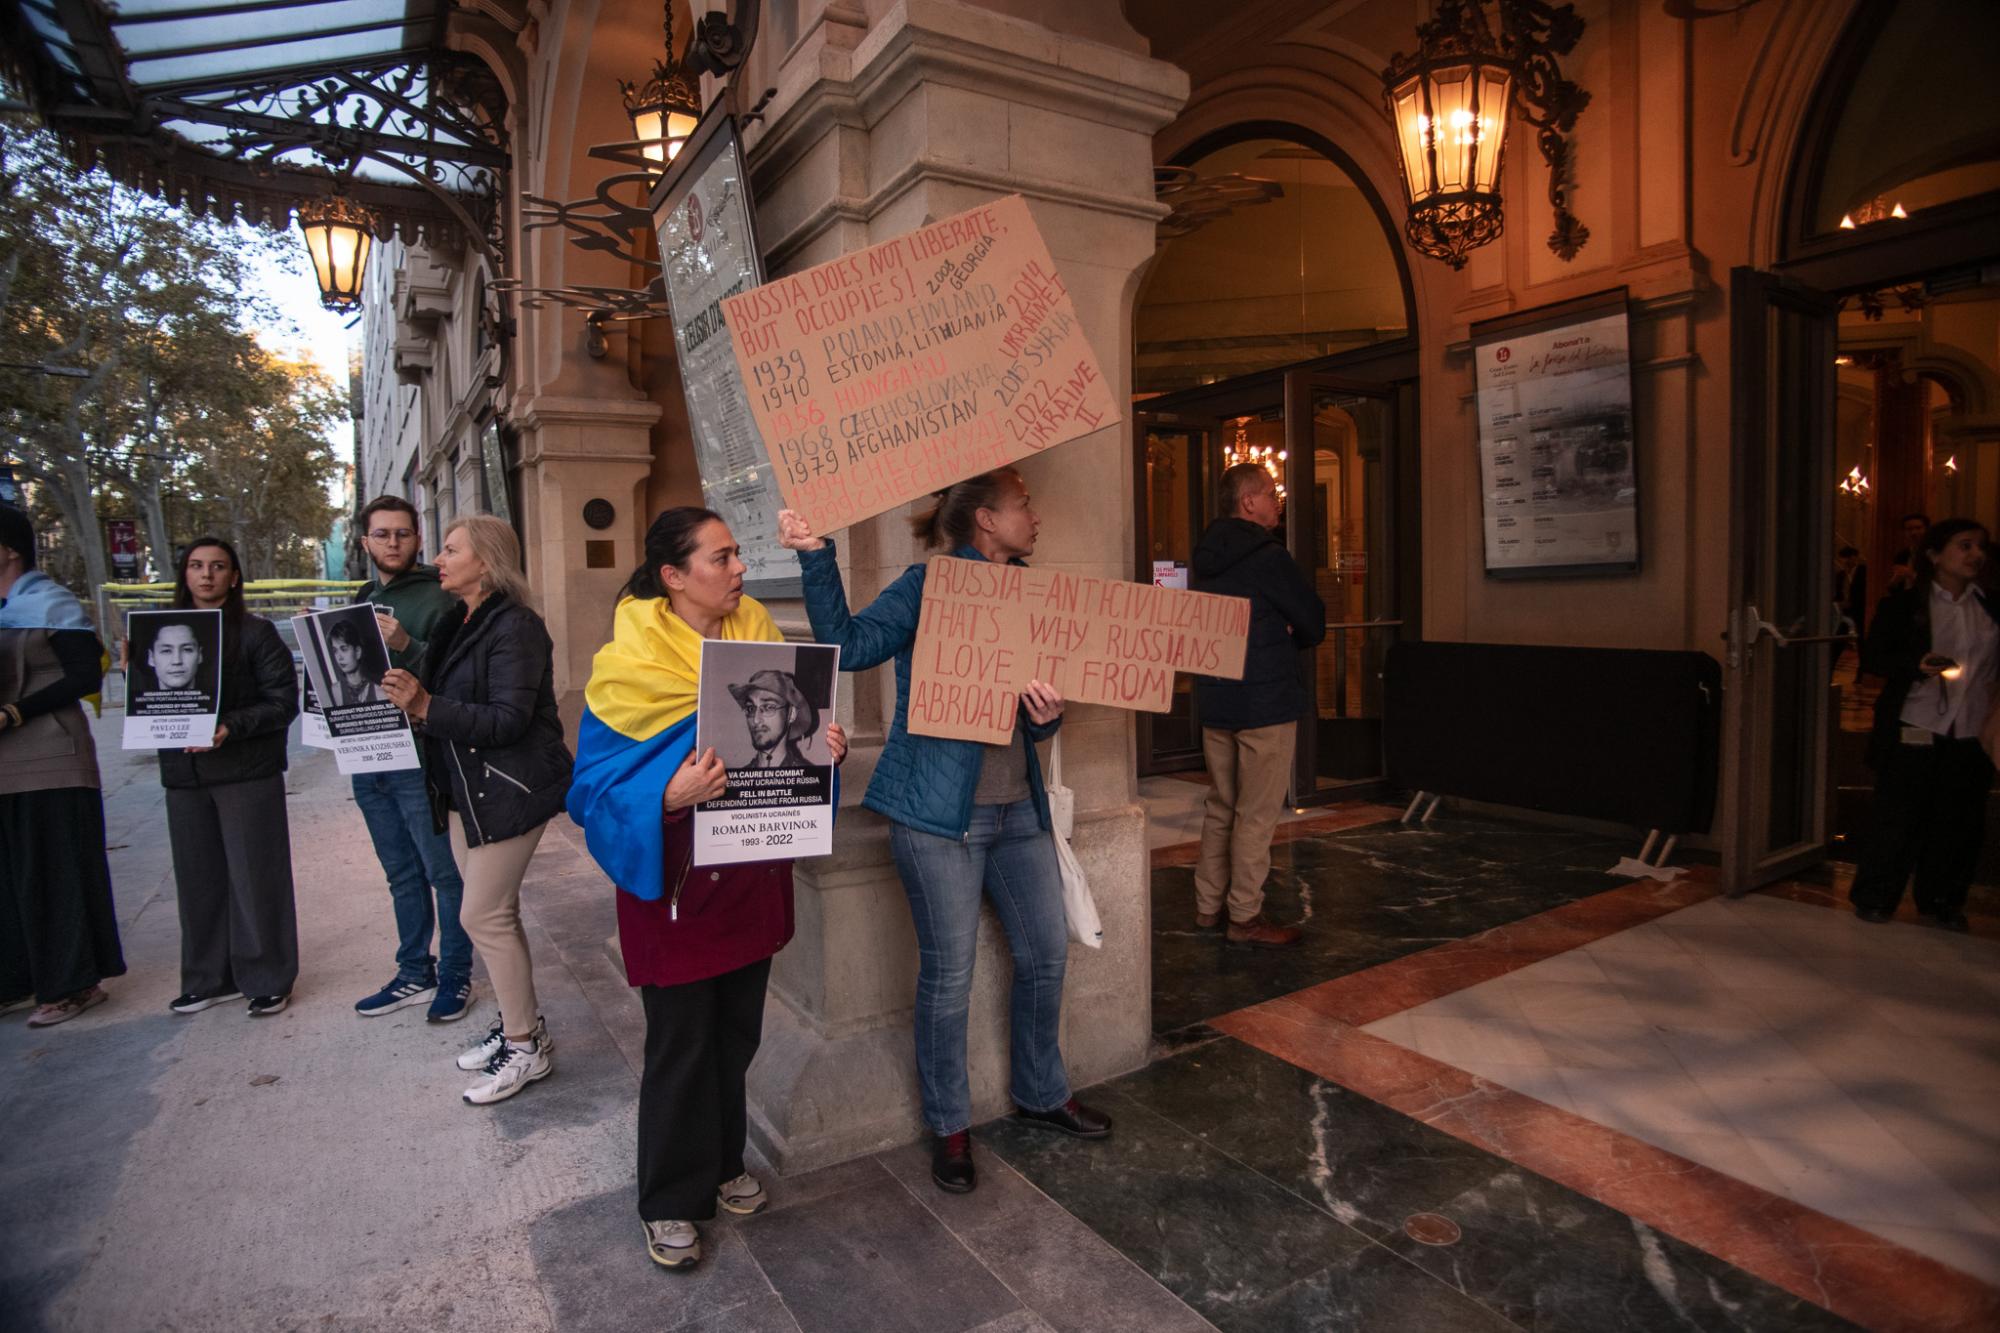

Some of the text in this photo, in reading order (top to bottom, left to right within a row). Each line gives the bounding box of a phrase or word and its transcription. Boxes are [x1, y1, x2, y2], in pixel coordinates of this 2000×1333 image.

[728, 277, 809, 332] RUSSIA
[810, 256, 863, 297] DOES
[869, 239, 904, 277] NOT
[926, 258, 956, 295] 2008
[949, 234, 996, 291] GEORGIA
[1006, 259, 1051, 316] 2014
[740, 320, 781, 358] BUT
[999, 287, 1059, 359] UKRAINE
[753, 349, 806, 387] 1939
[762, 375, 810, 412] 1940
[913, 303, 1008, 351] LITHUANIA
[994, 312, 1073, 407] 2015 SYRIA
[770, 399, 825, 439] 1956
[1005, 379, 1062, 441] 2022
[1025, 360, 1098, 450] UKRAINE
[779, 424, 833, 465] 1968
[787, 390, 977, 486] 1979 AFGHANISTAN
[923, 597, 1222, 671] THAT'S WHY RUSSIANS
[935, 640, 1015, 685] LOVE
[1081, 661, 1167, 705] FROM
[911, 679, 1018, 732] ABROAD
[726, 779, 754, 787] ENSANT
[740, 790, 757, 798] FELL
[766, 789, 792, 797] BATTLE
[775, 769, 804, 777] COMBAT
[706, 795, 823, 809] DEFENDING UKRAINE FROM RUSSIA
[731, 811, 768, 820] VIOLINISTA
[712, 819, 818, 836] ROMAN BARVINOK
[741, 833, 793, 847] 1993 2022
